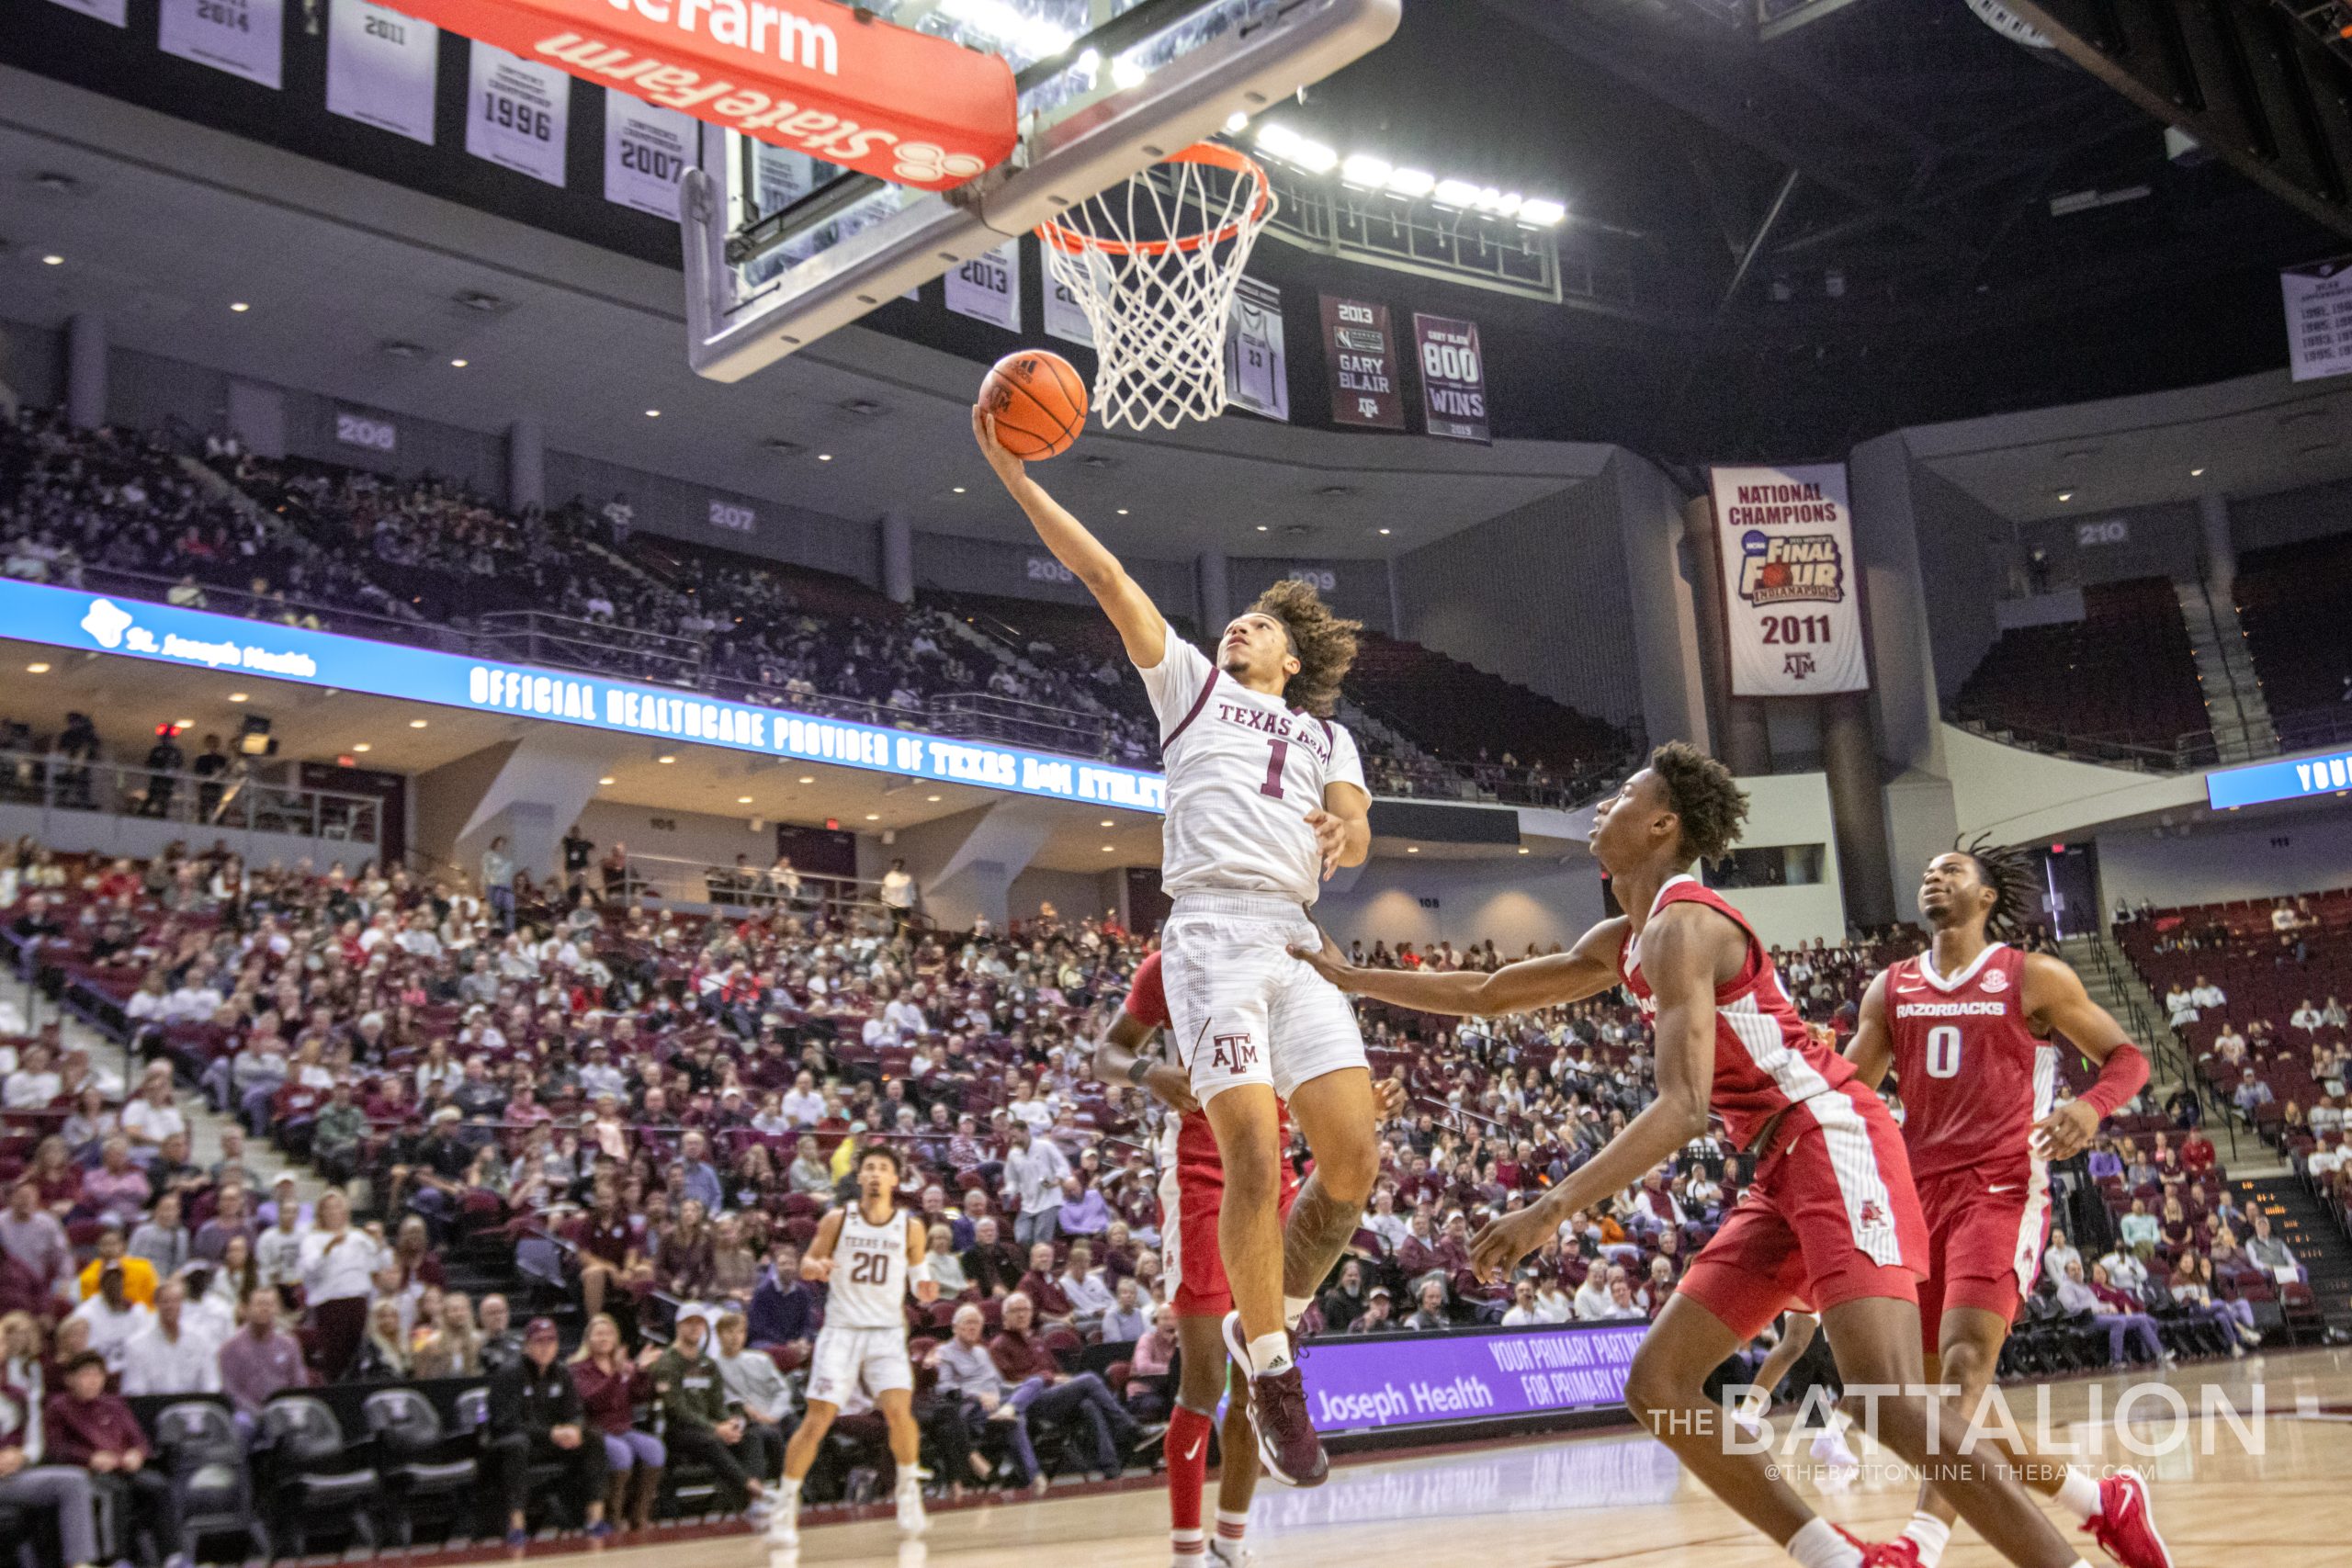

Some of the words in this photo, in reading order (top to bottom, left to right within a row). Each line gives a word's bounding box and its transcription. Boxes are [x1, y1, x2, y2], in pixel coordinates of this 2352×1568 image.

[364, 15, 405, 46] 2011
[485, 93, 551, 142] 1996
[620, 139, 684, 184] 2007
[960, 260, 1008, 295] 2013
[1338, 304, 1374, 325] 2013
[1339, 355, 1384, 376] GARY
[1422, 342, 1479, 383] 800
[1338, 371, 1391, 394] BLAIR
[1428, 387, 1485, 419] WINS
[1737, 482, 1823, 504] NATIONAL
[709, 502, 753, 530] 207
[1729, 503, 1837, 525] CHAMPIONS
[2080, 523, 2126, 544] 210
[1767, 539, 1836, 563] FINAL
[1755, 586, 1838, 602] INDIANAPOLIS
[1760, 615, 1830, 645] 2011
[469, 666, 596, 721] OFFICIAL
[605, 689, 765, 747] HEALTHCARE
[774, 716, 889, 766] PROVIDER
[896, 737, 923, 772] OF
[928, 741, 1016, 786] TEXAS
[1219, 704, 1293, 737] TEXAS
[1260, 739, 1288, 800] 1
[2296, 755, 2352, 792] YOU
[1896, 1001, 2007, 1020] RAZORBACKS
[1926, 1025, 1961, 1079] 0
[845, 1235, 878, 1249] TEXAS
[851, 1251, 889, 1286] 20
[1488, 1338, 1534, 1373] YOUR
[1528, 1335, 1595, 1370] PRIMARY
[1317, 1382, 1409, 1426] Joseph
[1409, 1374, 1494, 1414] Health
[1521, 1373, 1556, 1406] FOR
[1549, 1366, 1616, 1403] PRIMARY
